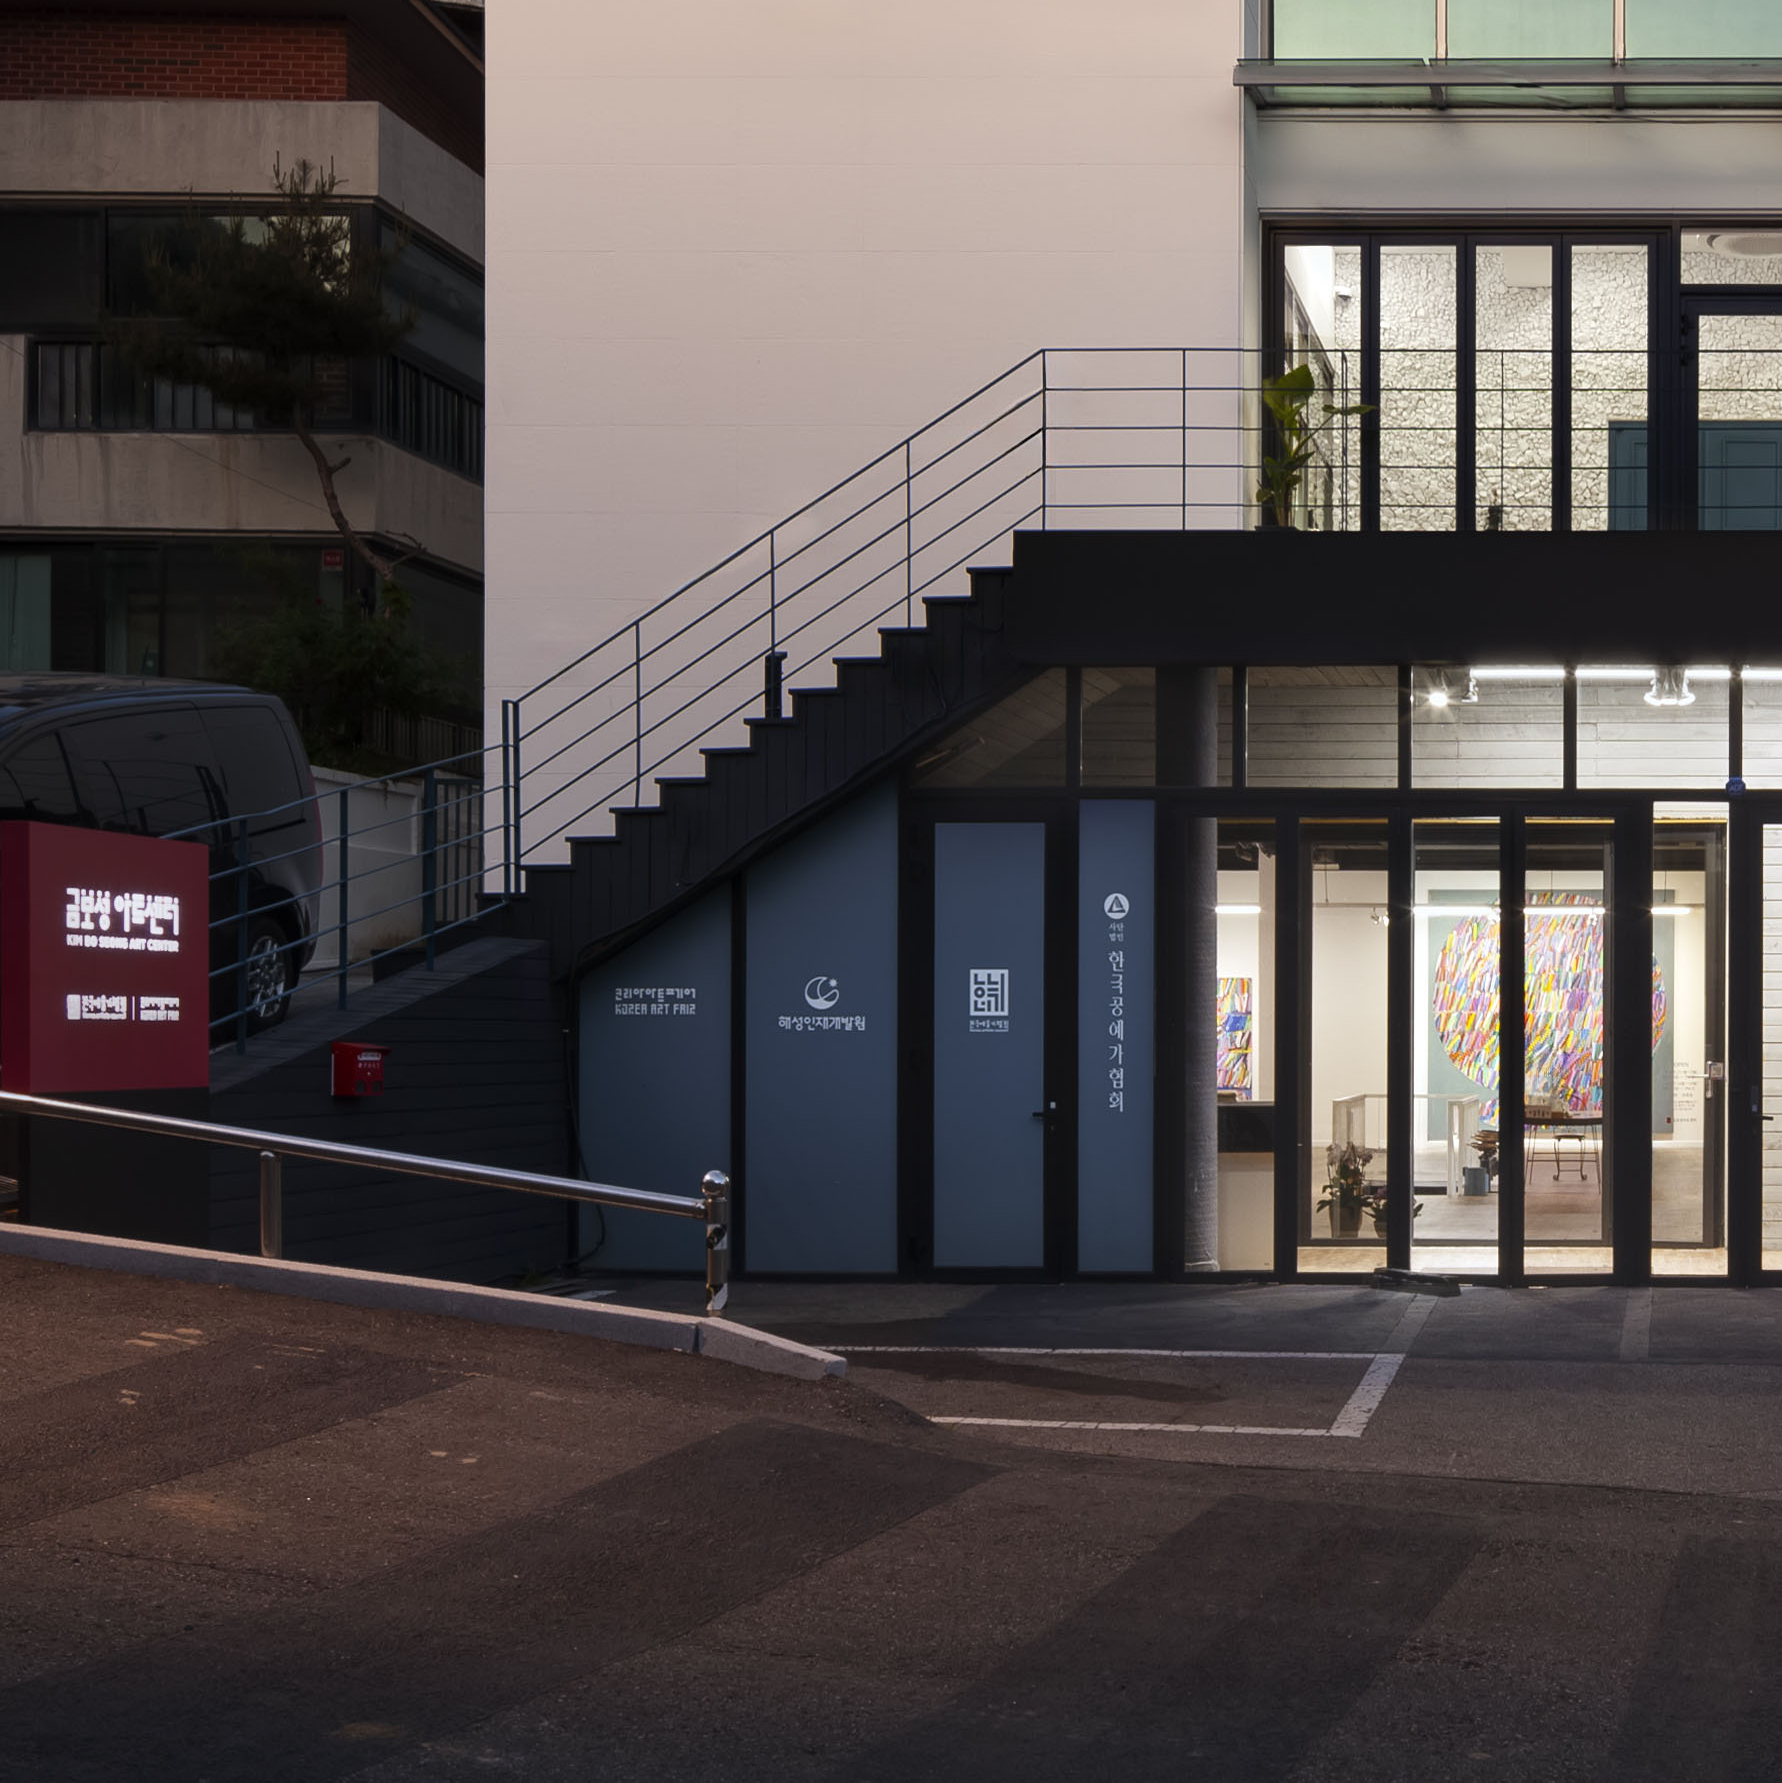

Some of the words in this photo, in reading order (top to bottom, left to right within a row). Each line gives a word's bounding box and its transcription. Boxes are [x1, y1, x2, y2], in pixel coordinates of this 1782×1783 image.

[615, 1003, 648, 1015] KOREA
[650, 1003, 670, 1015] ART
[673, 1003, 696, 1015] FAIR
